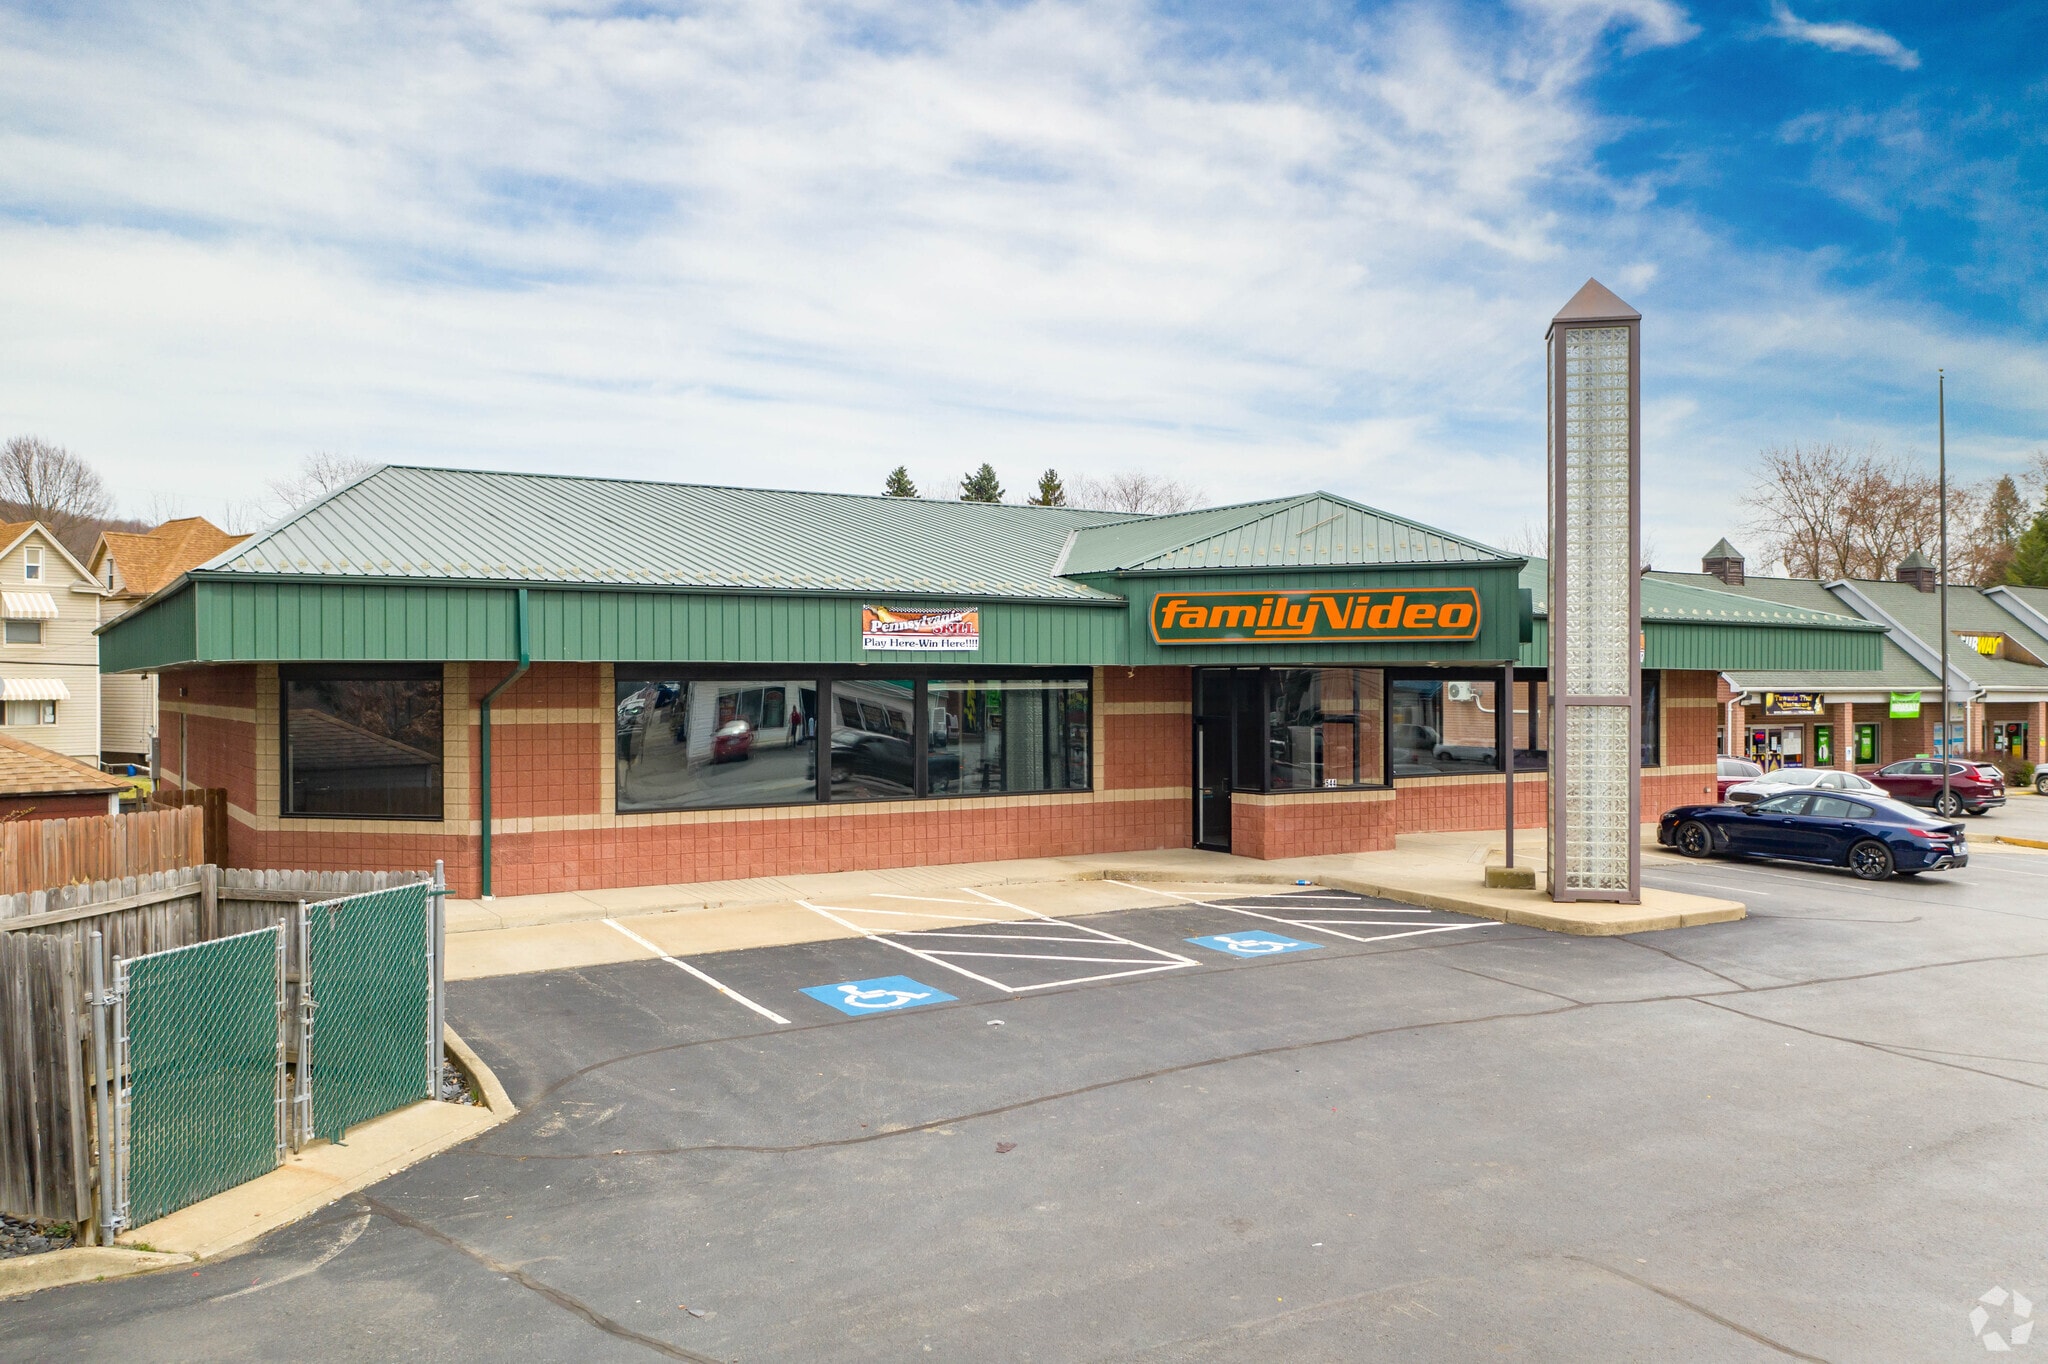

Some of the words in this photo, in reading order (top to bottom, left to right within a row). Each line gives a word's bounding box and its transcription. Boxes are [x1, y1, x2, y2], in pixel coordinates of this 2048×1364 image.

[870, 609, 963, 633] Pennsylvania
[864, 637, 887, 649] Play
[941, 638, 978, 648] Here!!!!
